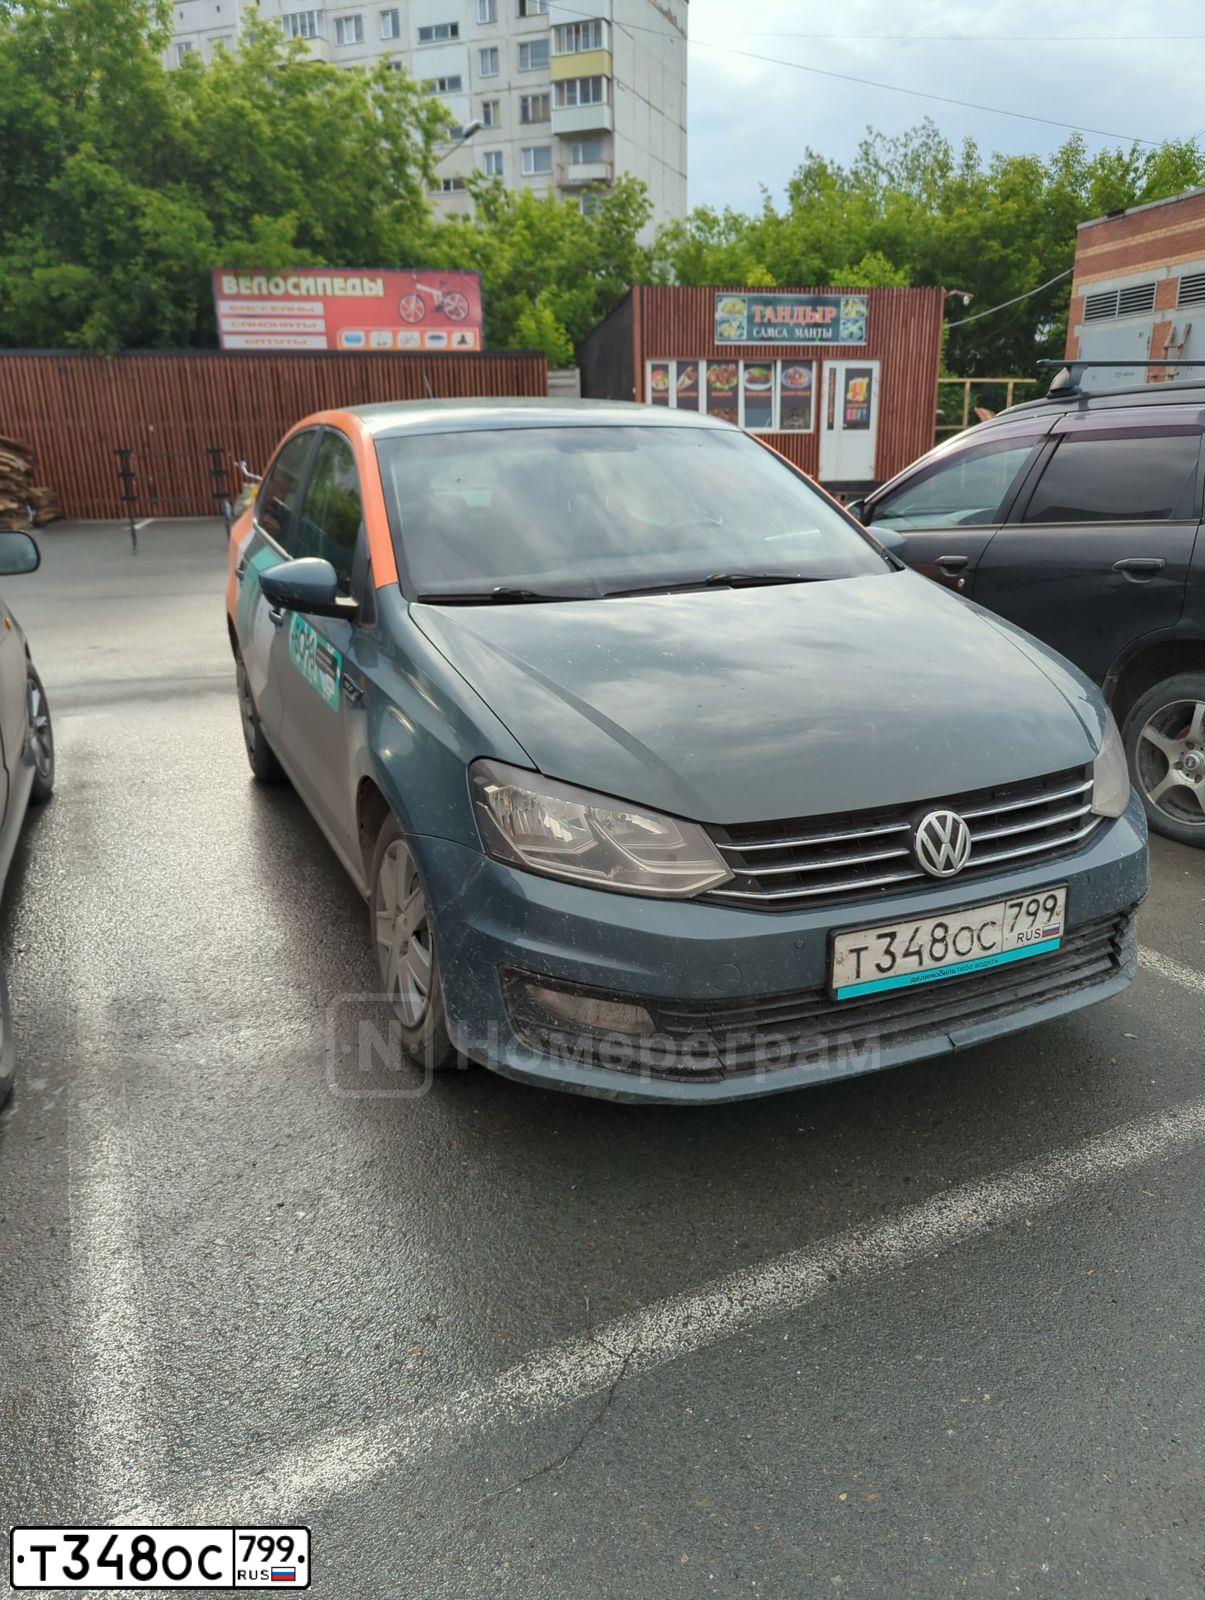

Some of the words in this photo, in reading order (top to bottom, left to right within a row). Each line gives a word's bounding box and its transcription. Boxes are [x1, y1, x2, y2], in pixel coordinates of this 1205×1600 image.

[222, 275, 385, 297] ВЕЛОСИПЕДЫ
[752, 305, 837, 325] ТАНДЫР
[753, 327, 788, 338] САМСА
[795, 327, 832, 338] МАНТЫ
[848, 920, 997, 979] Т348ОС
[1008, 893, 1058, 934] 799
[1017, 928, 1041, 944] RUS
